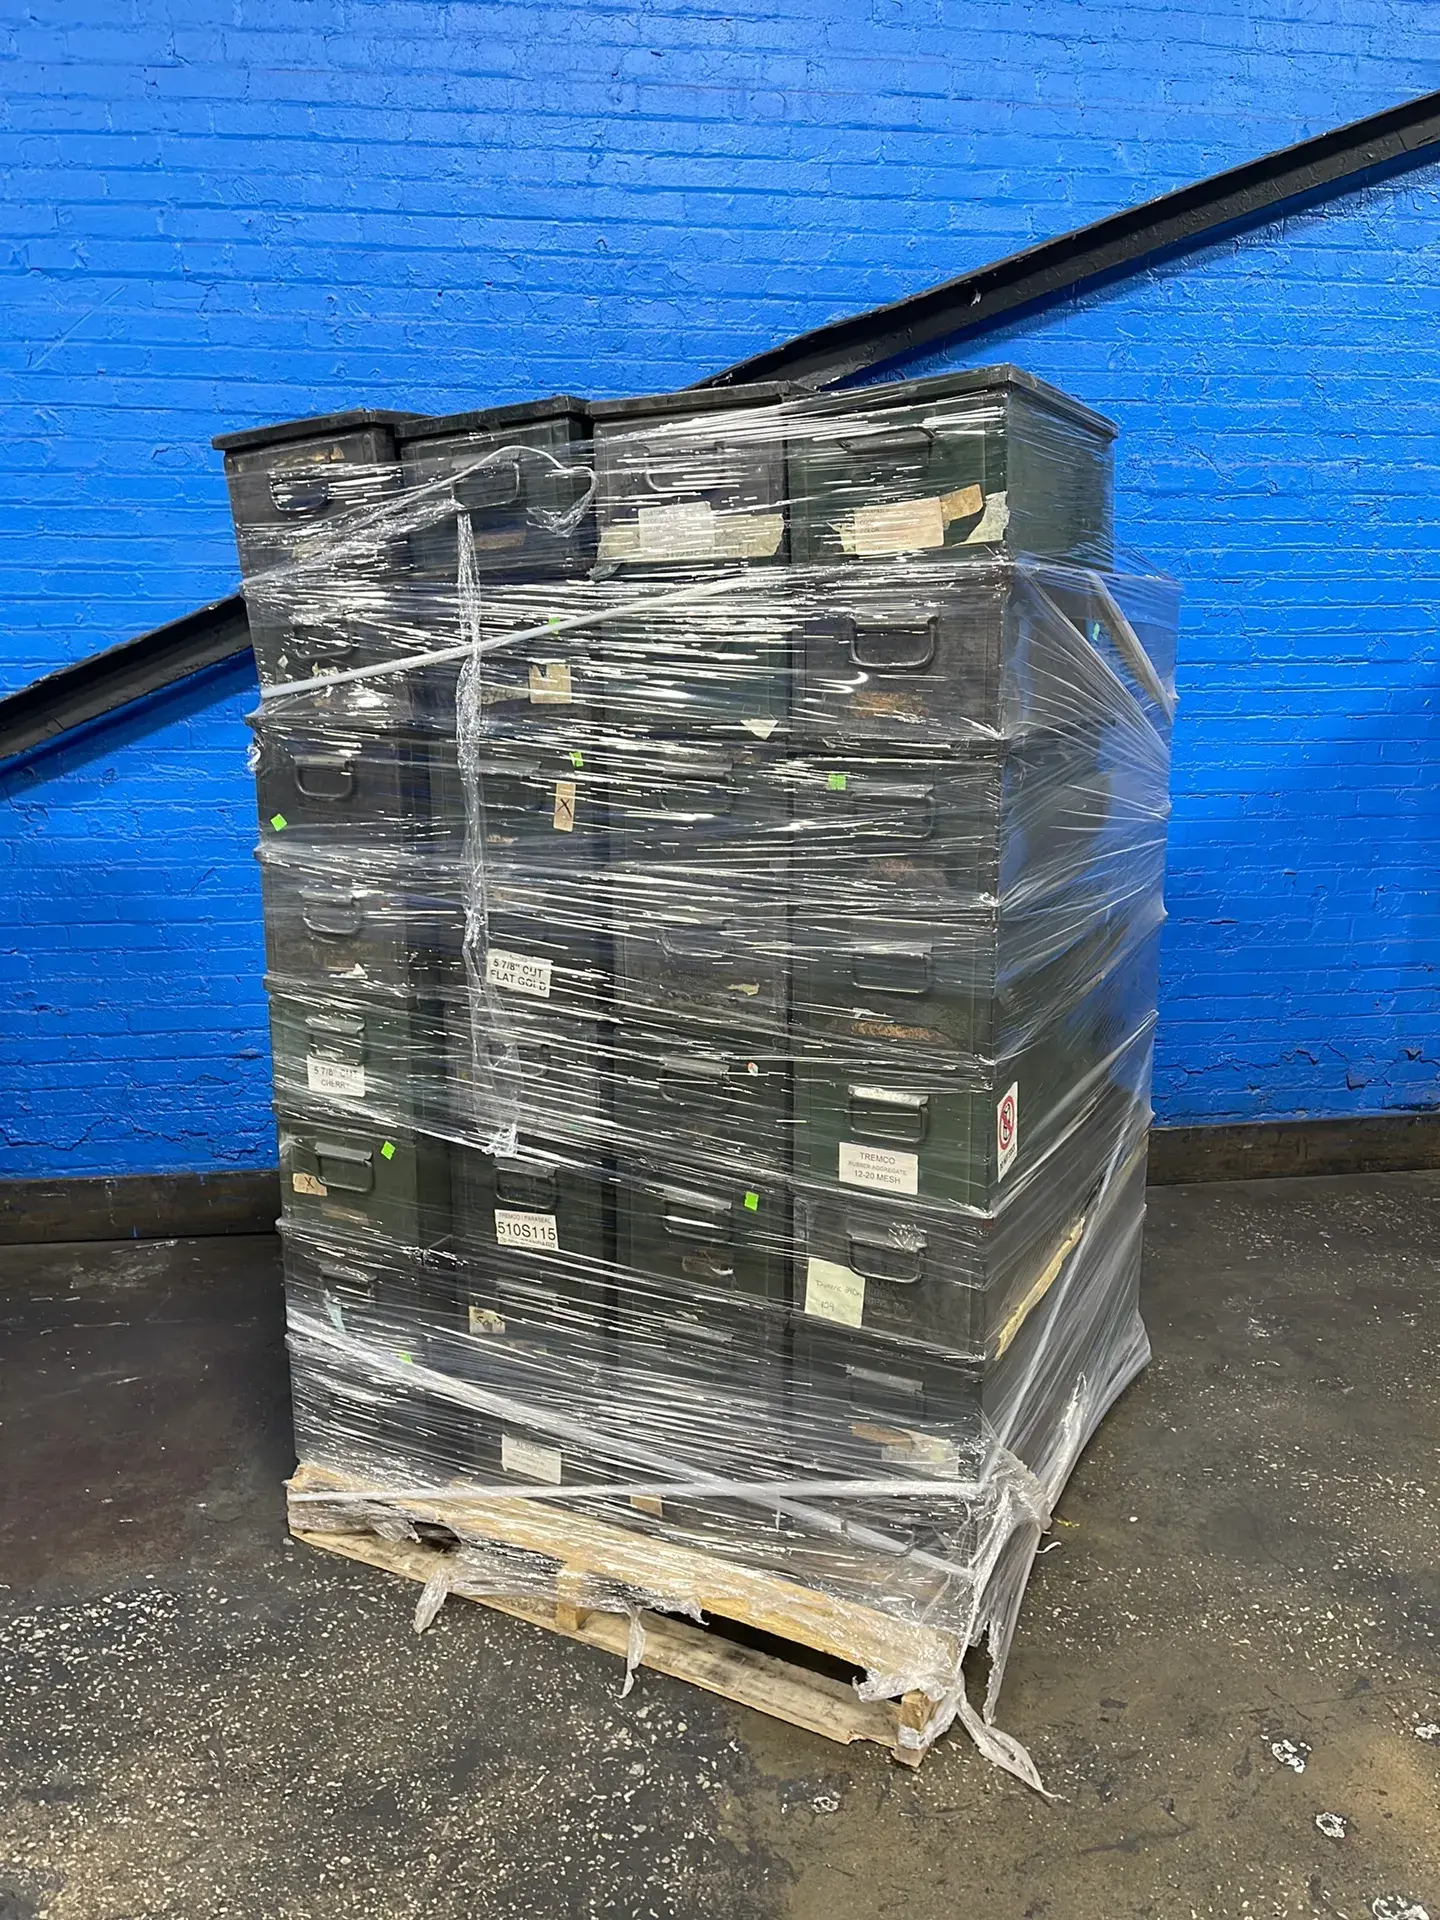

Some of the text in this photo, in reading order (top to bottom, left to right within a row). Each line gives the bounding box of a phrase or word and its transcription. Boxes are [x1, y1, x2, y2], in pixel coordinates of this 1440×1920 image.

[522, 965, 544, 978] CUT
[860, 1152, 896, 1165] TREMCO
[854, 1170, 901, 1185] 12-20 MESH
[497, 1221, 556, 1241] 510S115
